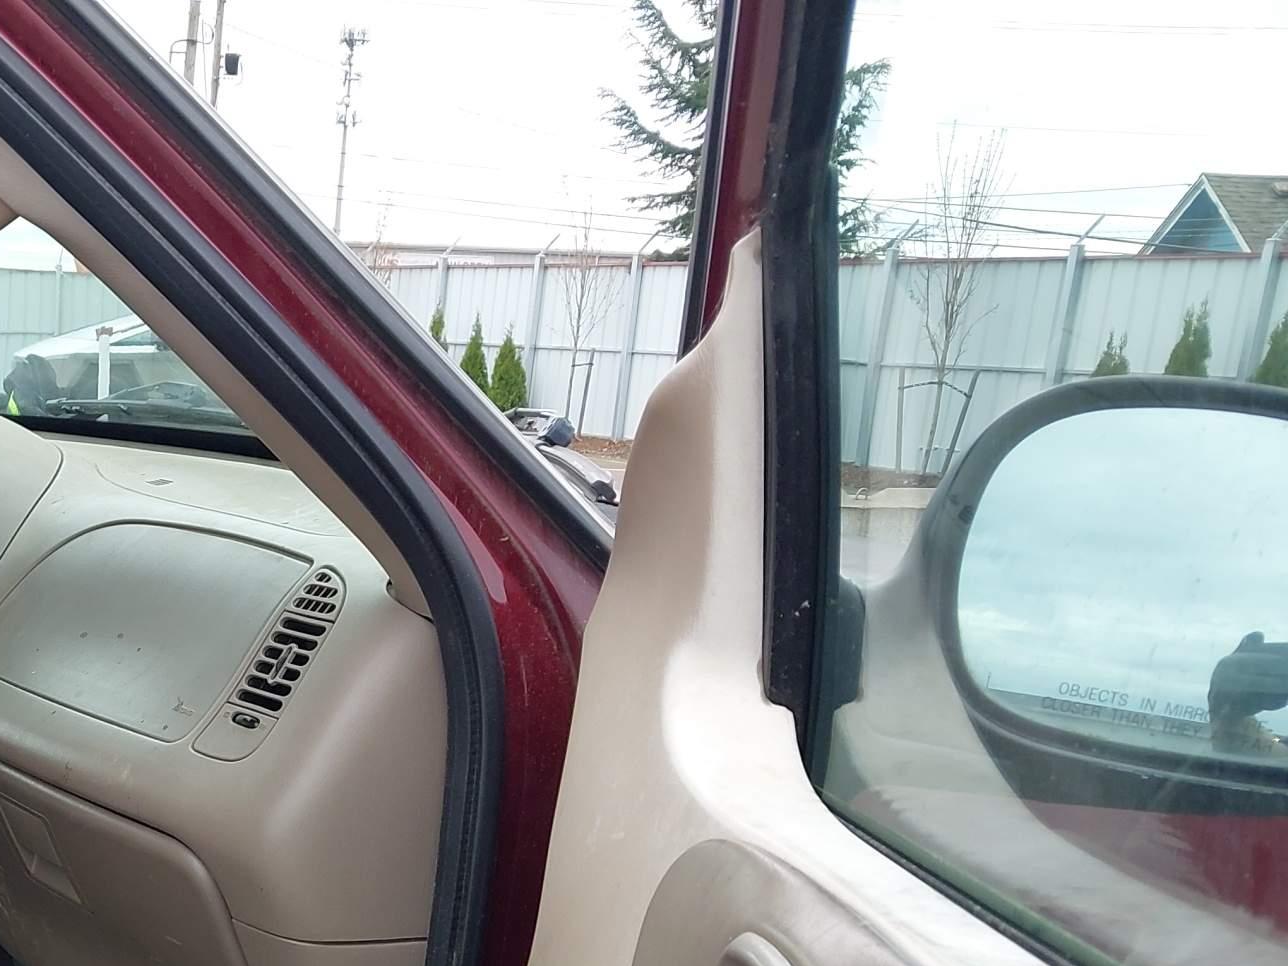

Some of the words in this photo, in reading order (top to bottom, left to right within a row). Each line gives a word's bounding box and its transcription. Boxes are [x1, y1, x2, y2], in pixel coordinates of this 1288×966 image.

[1040, 695, 1102, 719] CLOSER
[1111, 706, 1152, 729] THAN
[1162, 718, 1205, 738] THEY
[1057, 681, 1130, 707] OBJECTS
[1139, 697, 1158, 713] IN
[1163, 701, 1210, 723] MIRRO
